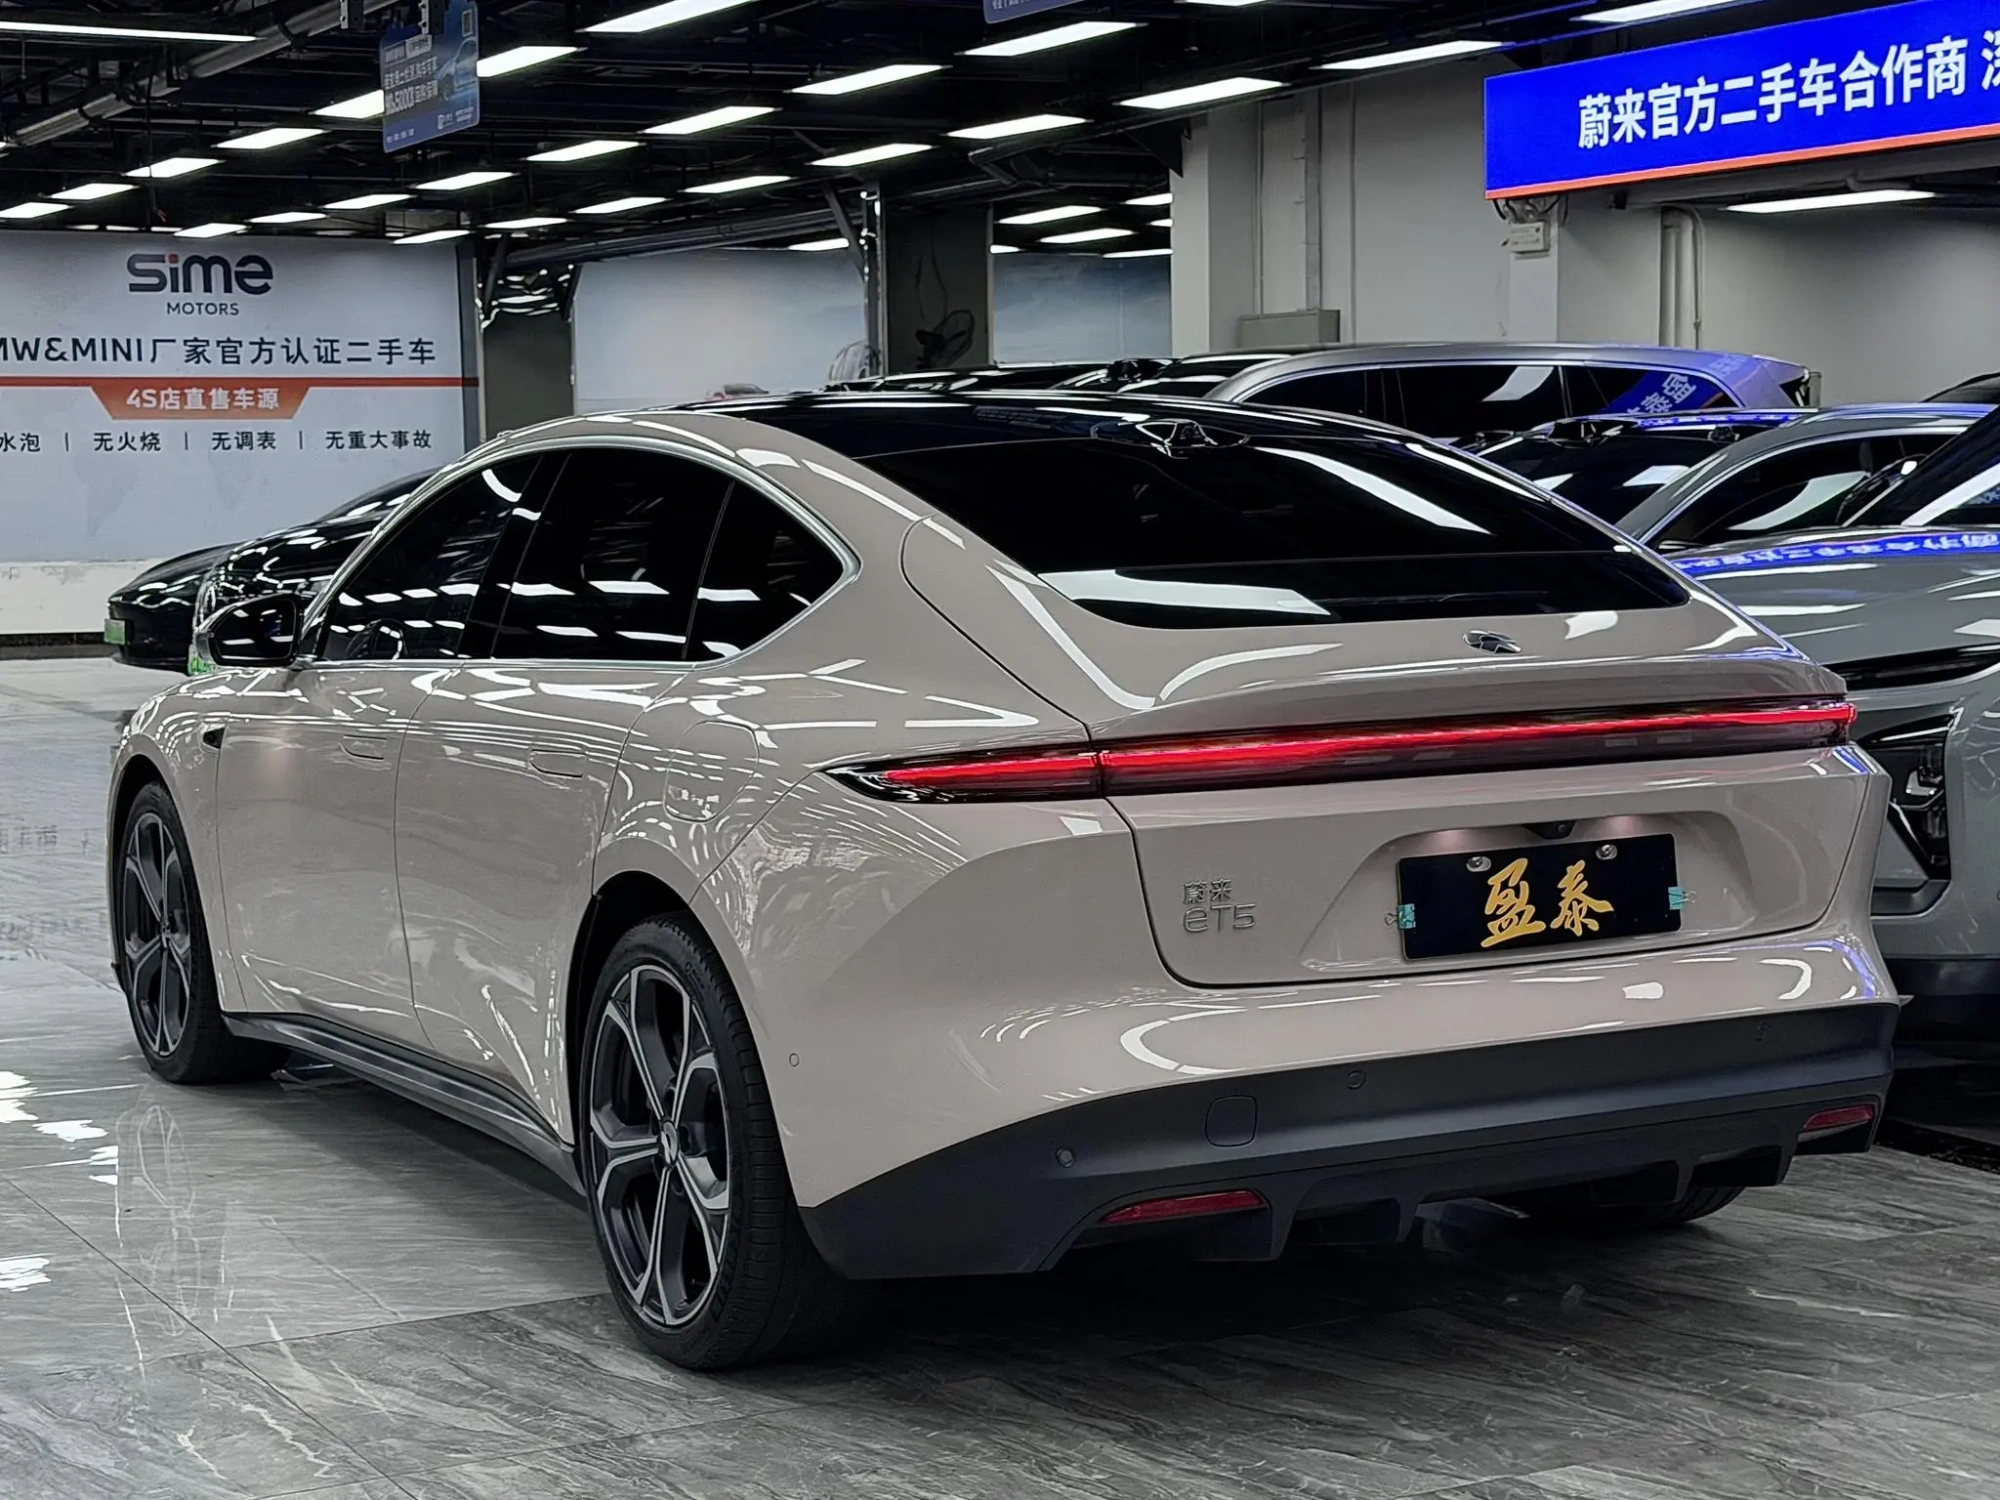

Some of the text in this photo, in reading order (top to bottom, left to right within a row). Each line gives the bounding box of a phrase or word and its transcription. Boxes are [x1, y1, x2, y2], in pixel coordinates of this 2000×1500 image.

[1578, 35, 1968, 150] 蔚来官方二手车合作商
[166, 302, 240, 316] MOTORS
[126, 387, 280, 410] 4S店直售车源
[94, 431, 162, 452] 无火烧
[211, 430, 277, 451] 无调表
[325, 430, 432, 450] 无重大事故
[1481, 858, 1614, 948] 盈泰
